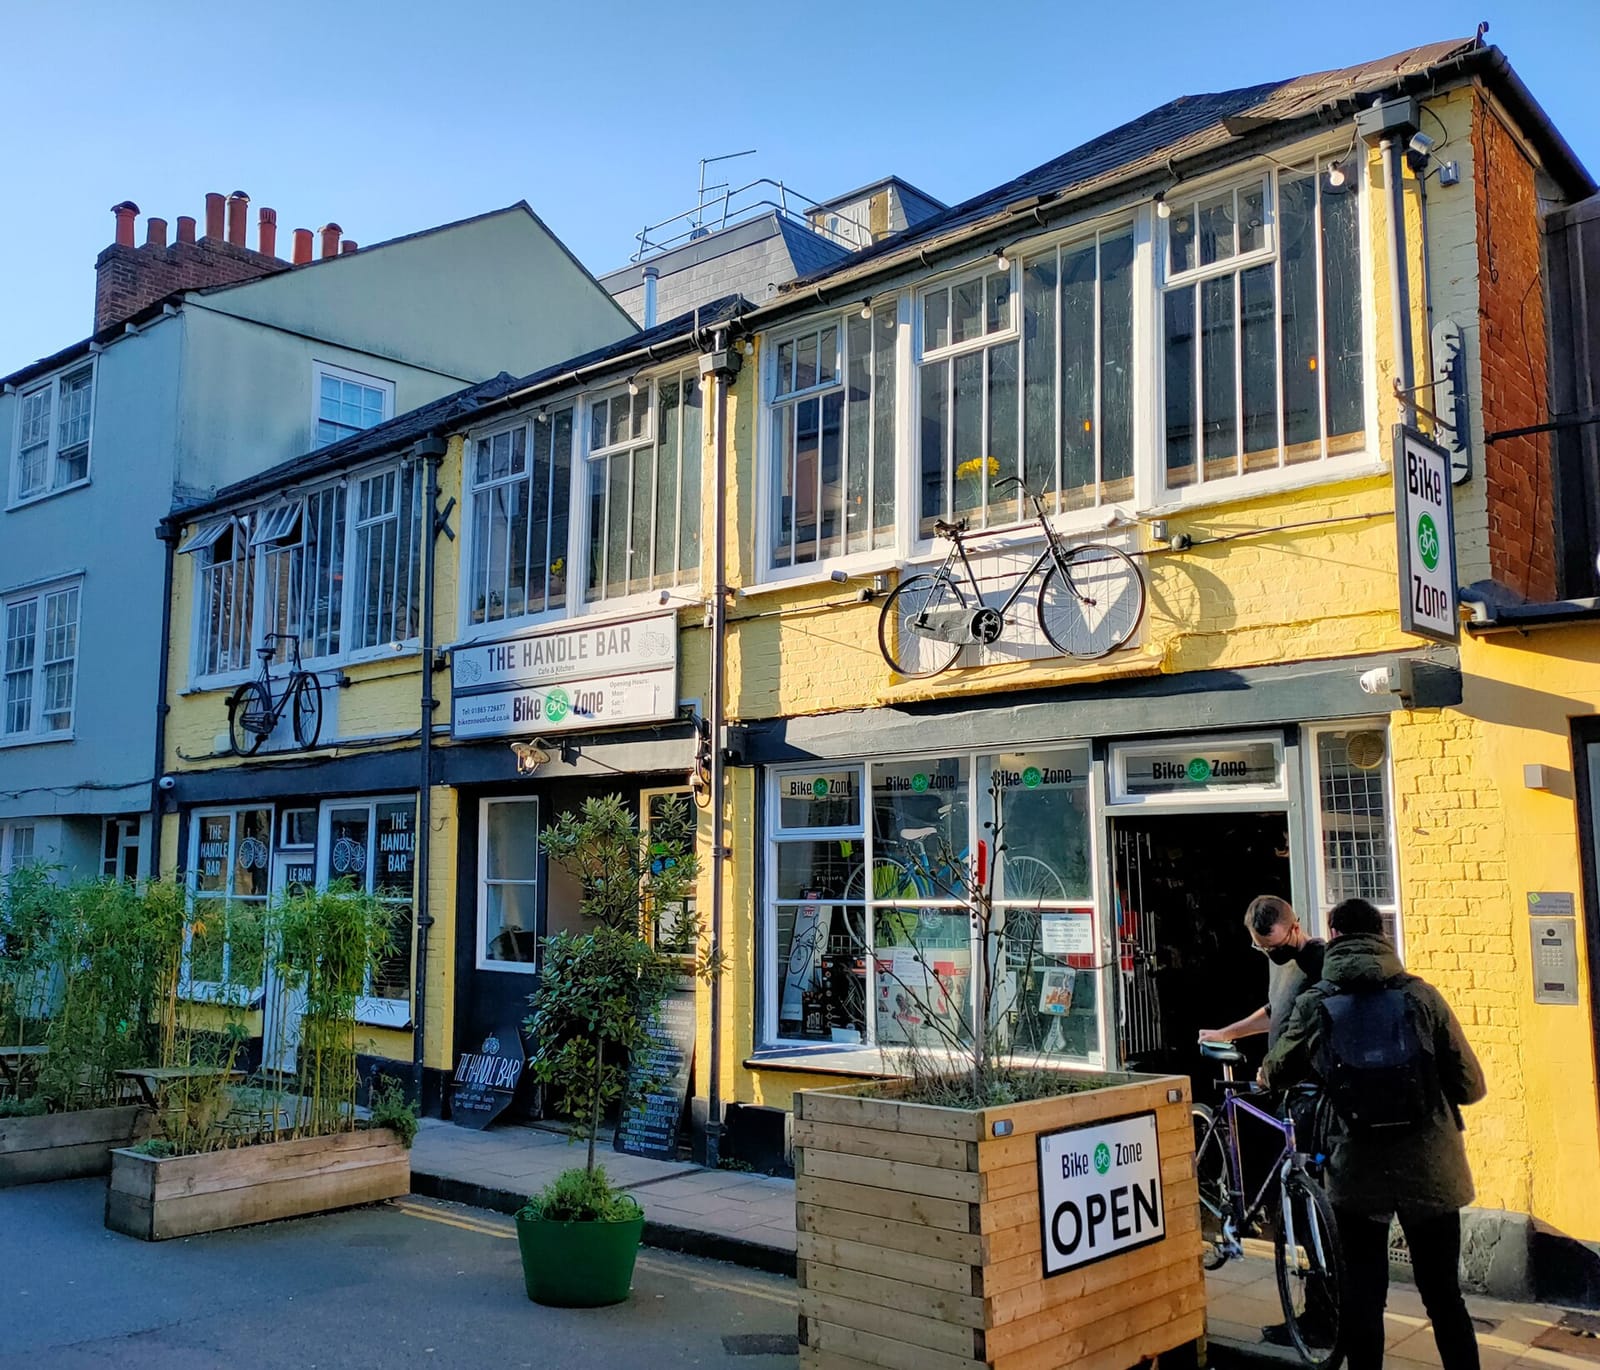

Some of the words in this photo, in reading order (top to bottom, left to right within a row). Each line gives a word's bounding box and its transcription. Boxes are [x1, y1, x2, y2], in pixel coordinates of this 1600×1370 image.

[1407, 451, 1442, 506] Bike
[1414, 575, 1448, 622] Zone
[487, 645, 516, 673] THE
[523, 634, 588, 667] HANDLE
[596, 627, 631, 657] BAR
[513, 696, 541, 722] Bike
[573, 689, 604, 716] Zone
[995, 769, 1020, 787] Bike
[1042, 768, 1073, 784] Zone
[1152, 762, 1185, 780] Bike
[1211, 759, 1247, 777] Zone
[790, 781, 812, 796] Bike
[829, 777, 852, 794] Zone
[886, 776, 910, 791] Bike
[929, 773, 955, 790] Zone
[391, 812, 408, 830] THE
[208, 824, 222, 841] THE
[380, 832, 416, 852] HANDLE
[201, 842, 229, 858] HANDLE
[206, 860, 221, 876] BAR
[388, 854, 407, 872] BAR
[289, 867, 297, 881] LE
[298, 867, 312, 881] BAR
[465, 1054, 502, 1086] HANDLE
[495, 1058, 521, 1089] BAR
[1061, 1151, 1089, 1180] Bike
[1115, 1142, 1143, 1167] Zone
[1051, 1178, 1160, 1256] OPEN
